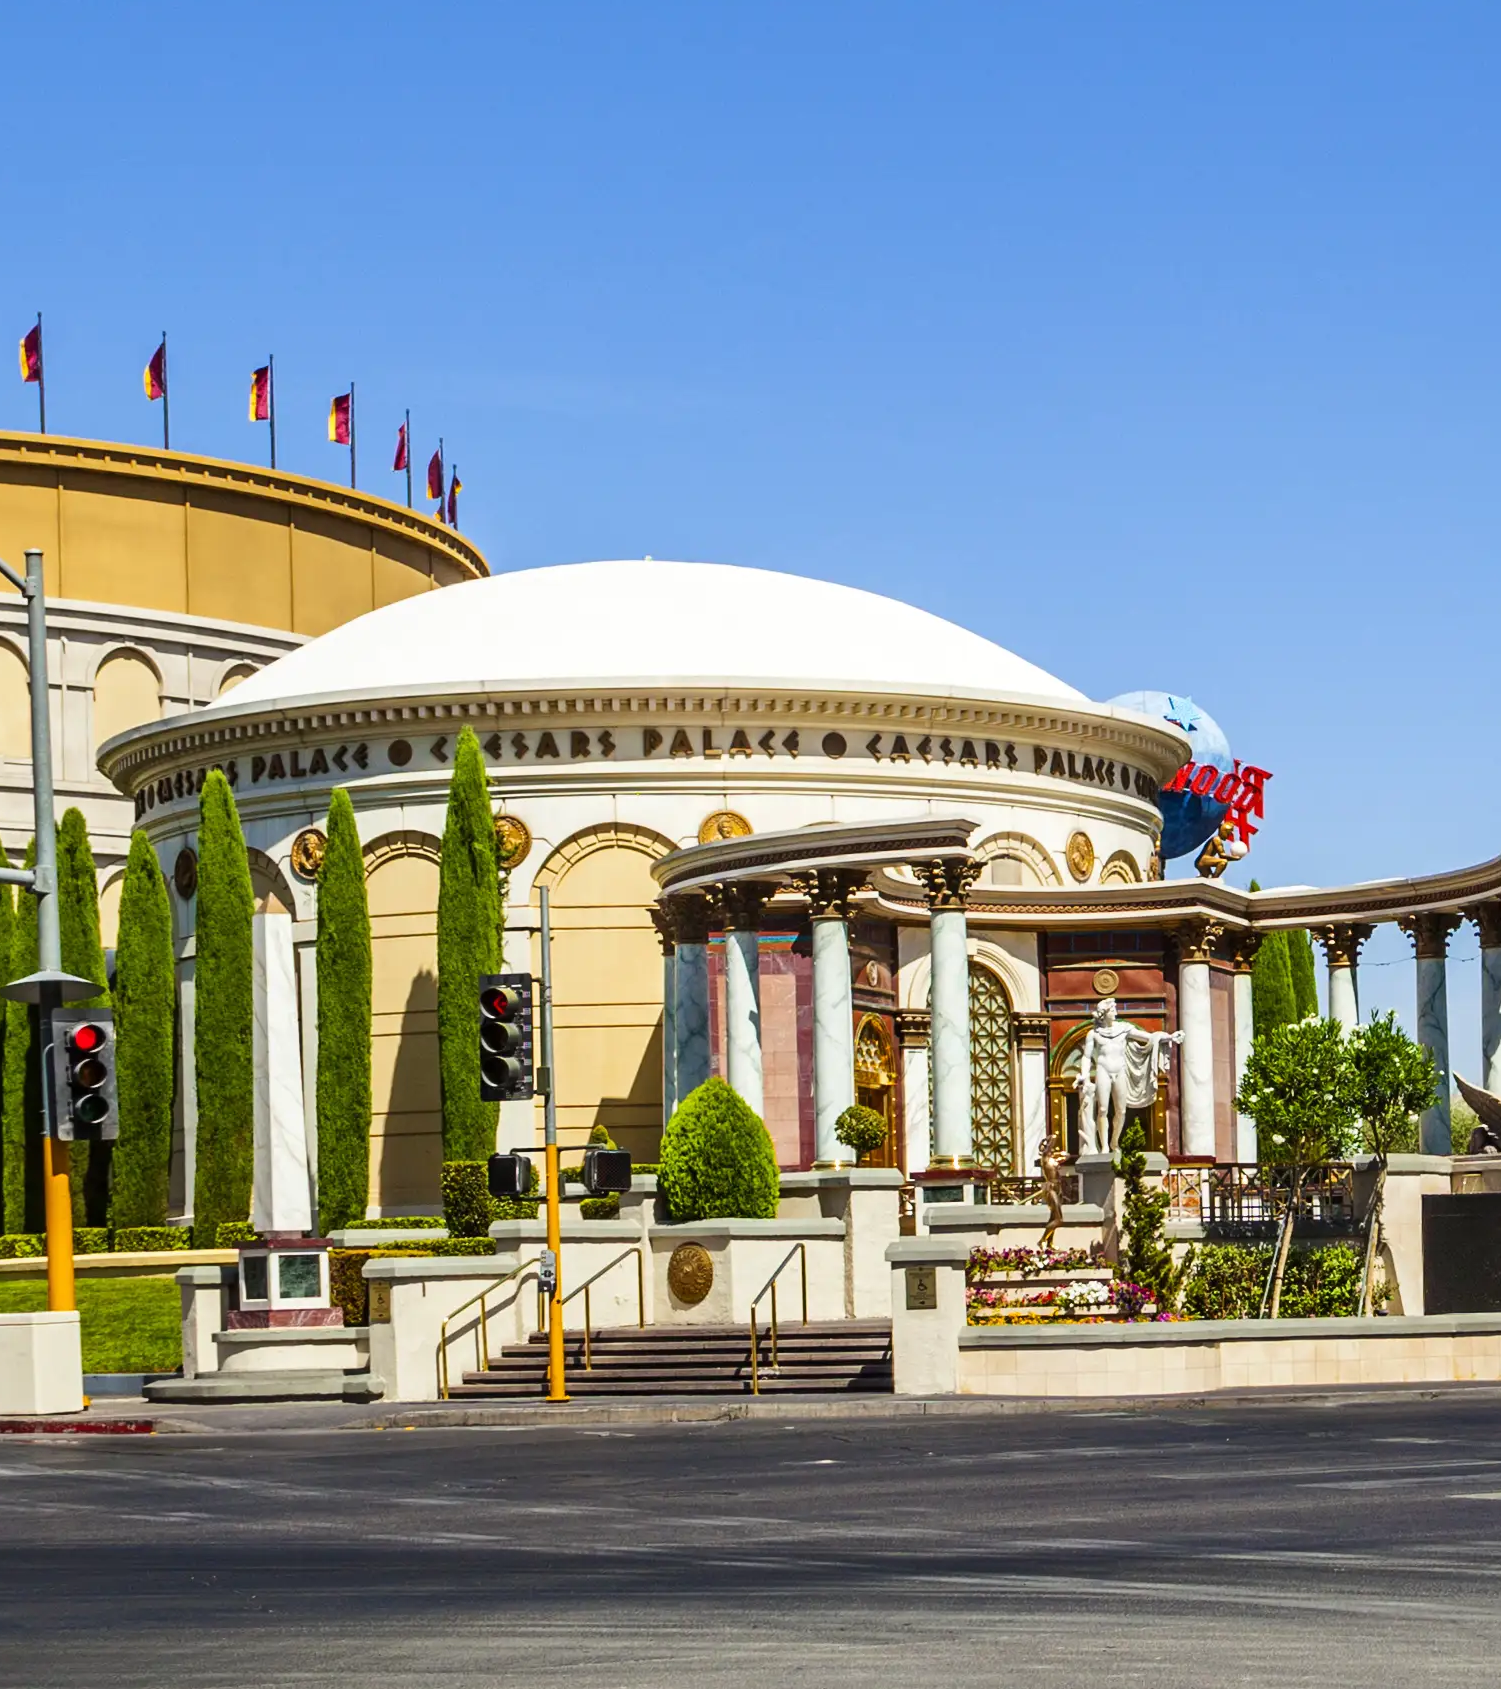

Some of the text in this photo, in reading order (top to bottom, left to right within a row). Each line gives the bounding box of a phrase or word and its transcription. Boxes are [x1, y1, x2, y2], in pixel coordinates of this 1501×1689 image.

[252, 743, 369, 783] PALACE
[430, 731, 617, 764] CESARS
[644, 728, 799, 760] PALACE
[866, 734, 1019, 772] CAESARS
[1034, 745, 1115, 788] PALACE
